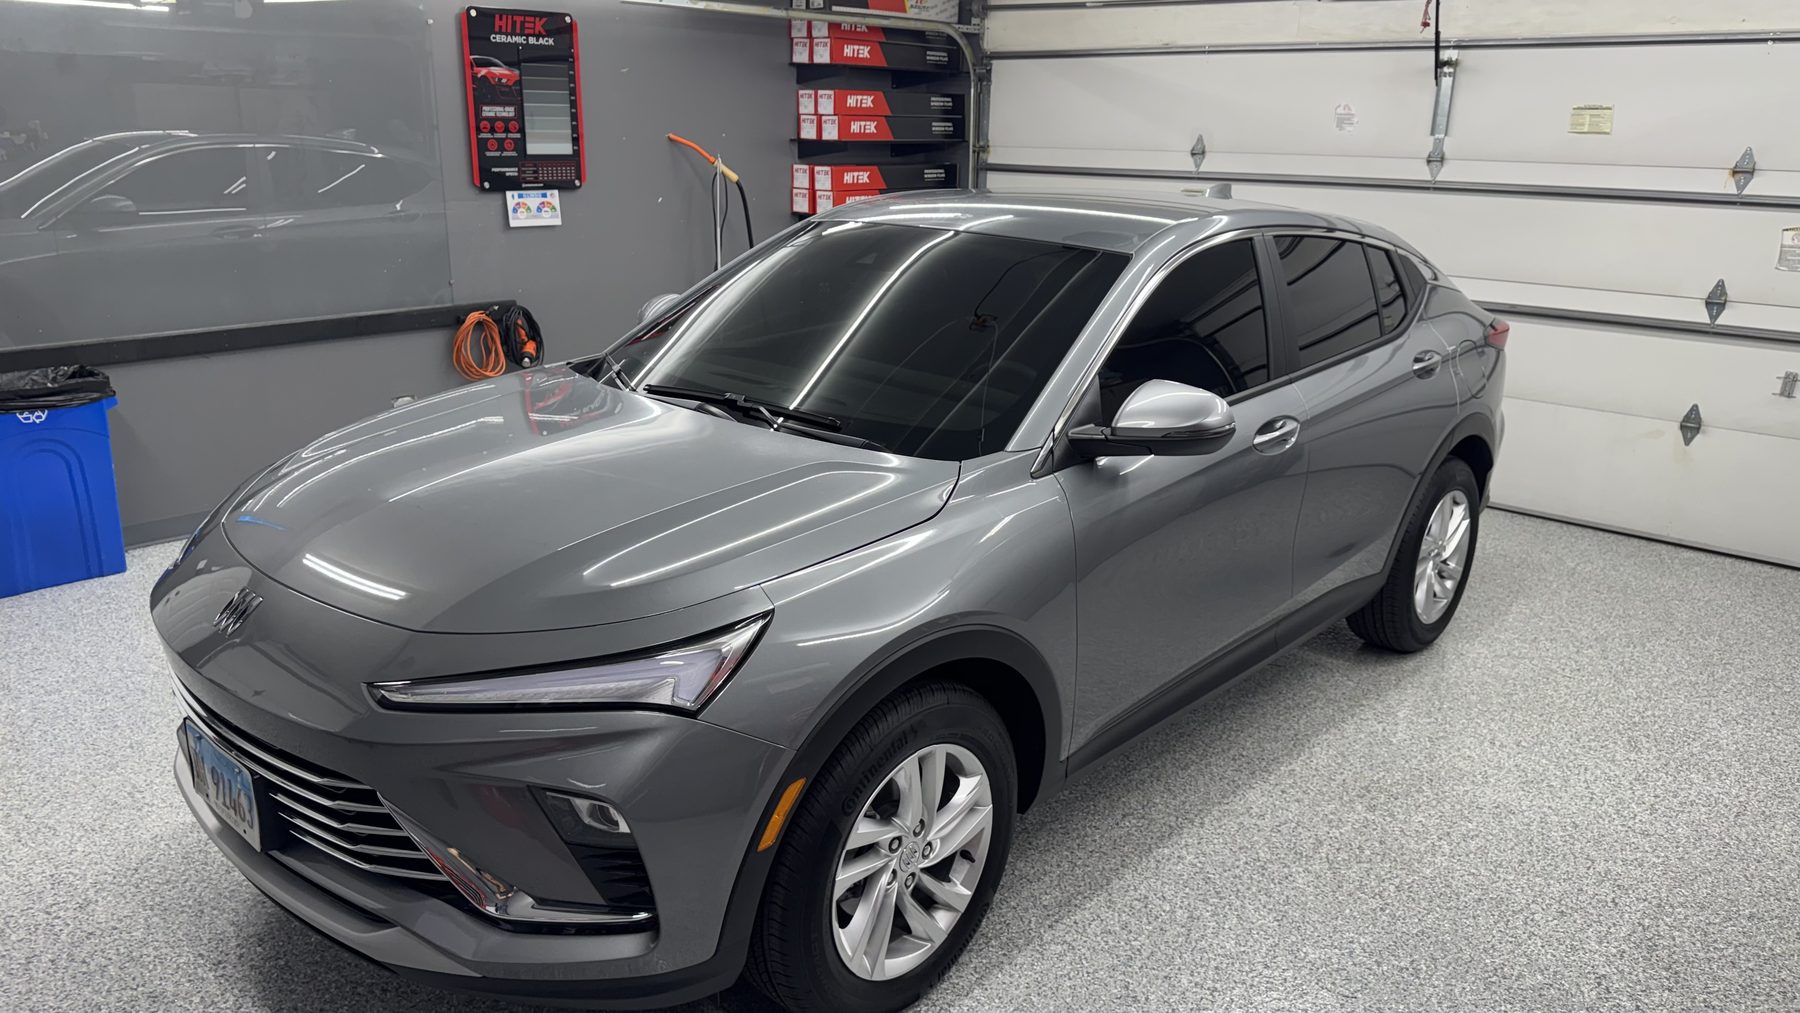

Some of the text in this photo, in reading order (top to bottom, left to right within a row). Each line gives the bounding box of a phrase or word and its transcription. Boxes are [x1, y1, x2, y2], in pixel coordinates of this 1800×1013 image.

[494, 14, 548, 35] HITEK
[490, 34, 555, 45] CERAMIC BLACK
[843, 44, 871, 59] HITEK
[846, 94, 875, 108] HITEK
[850, 120, 878, 134] HITEK
[843, 171, 870, 184] HITEK
